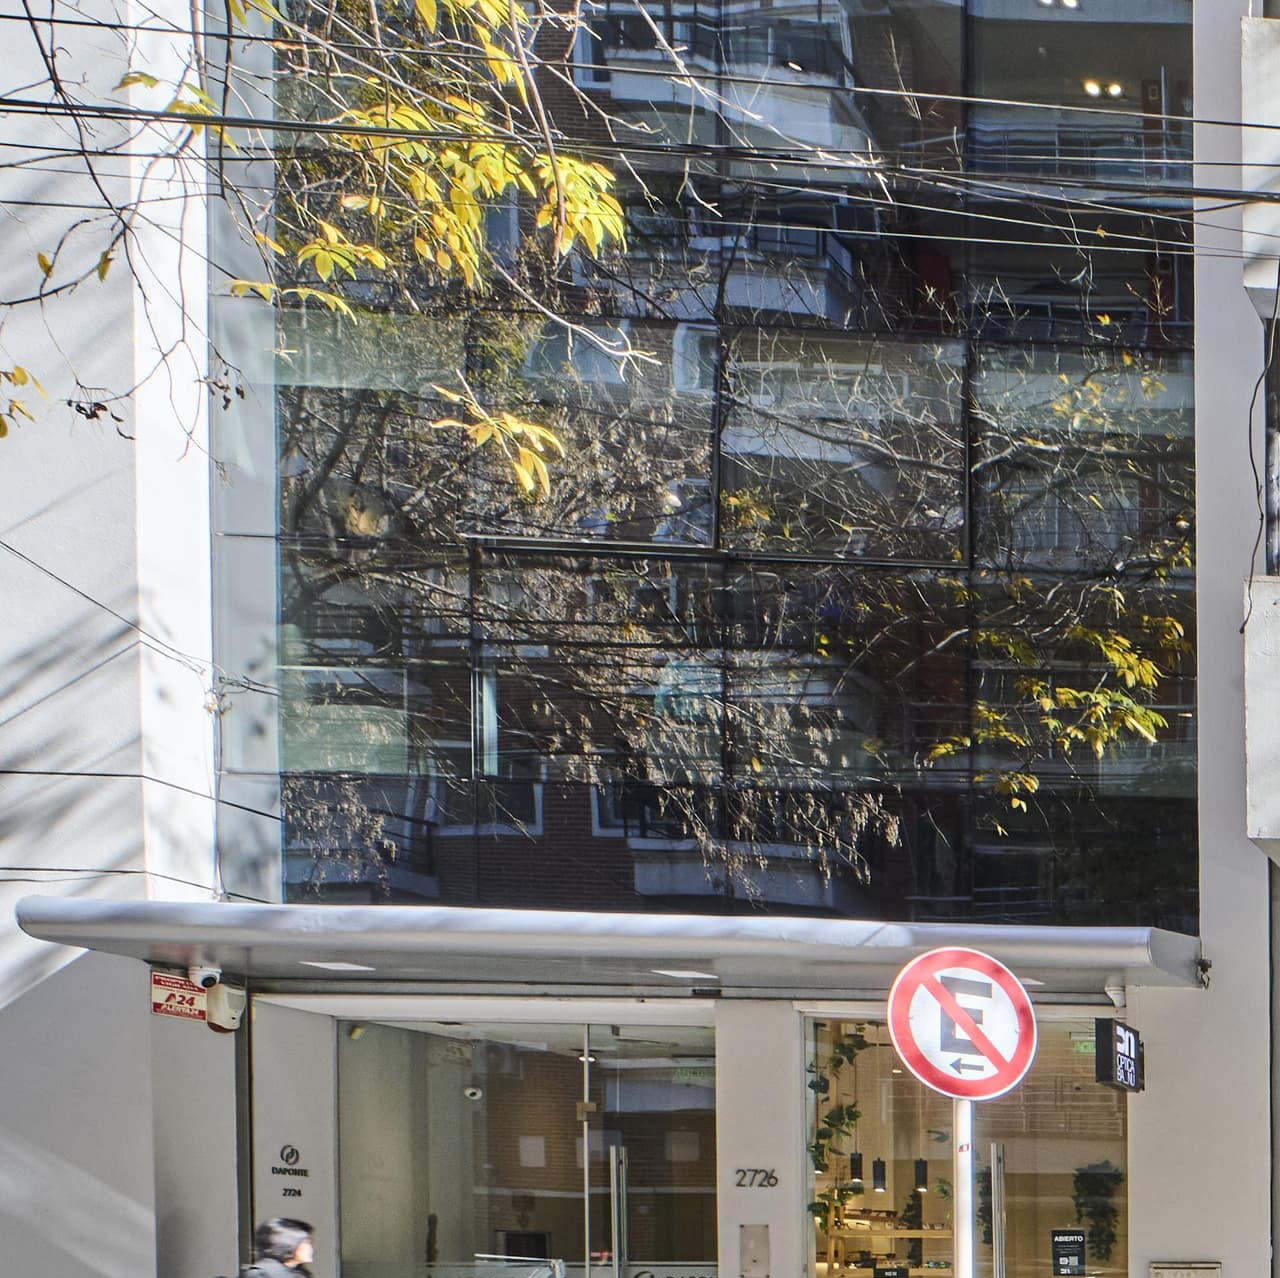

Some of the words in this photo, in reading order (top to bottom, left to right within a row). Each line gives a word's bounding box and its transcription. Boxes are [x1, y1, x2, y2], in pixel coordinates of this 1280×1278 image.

[165, 992, 195, 1007] A24
[941, 975, 992, 1058] E
[271, 1166, 309, 1177] DAPONTE
[735, 1168, 779, 1188] 2726
